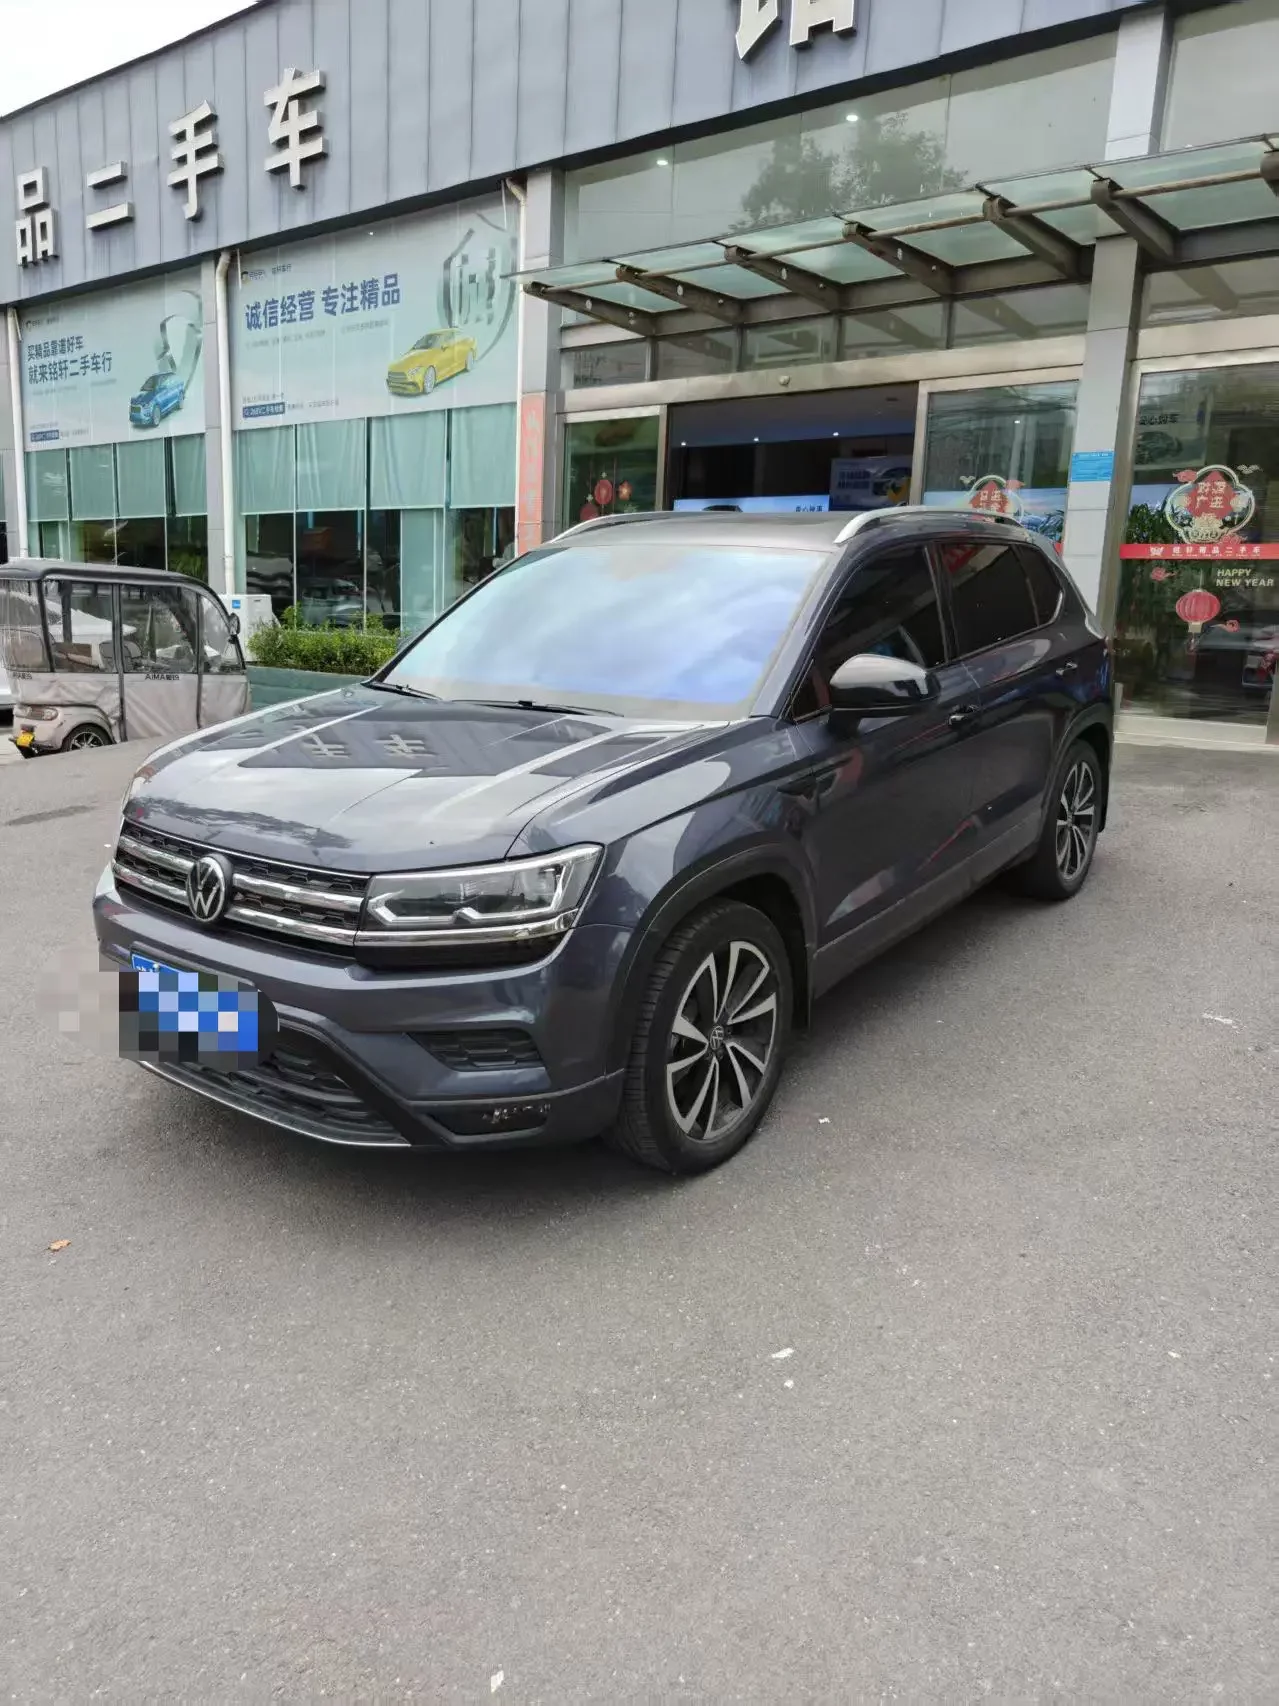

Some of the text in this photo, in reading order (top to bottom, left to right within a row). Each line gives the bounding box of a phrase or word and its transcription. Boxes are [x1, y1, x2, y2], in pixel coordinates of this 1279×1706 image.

[245, 272, 401, 331] 诚信经营 专注精品
[28, 351, 113, 385] 就来铭轩二手车行
[1216, 578, 1275, 587] NEW YEAR
[1217, 568, 1252, 577] HAPPY
